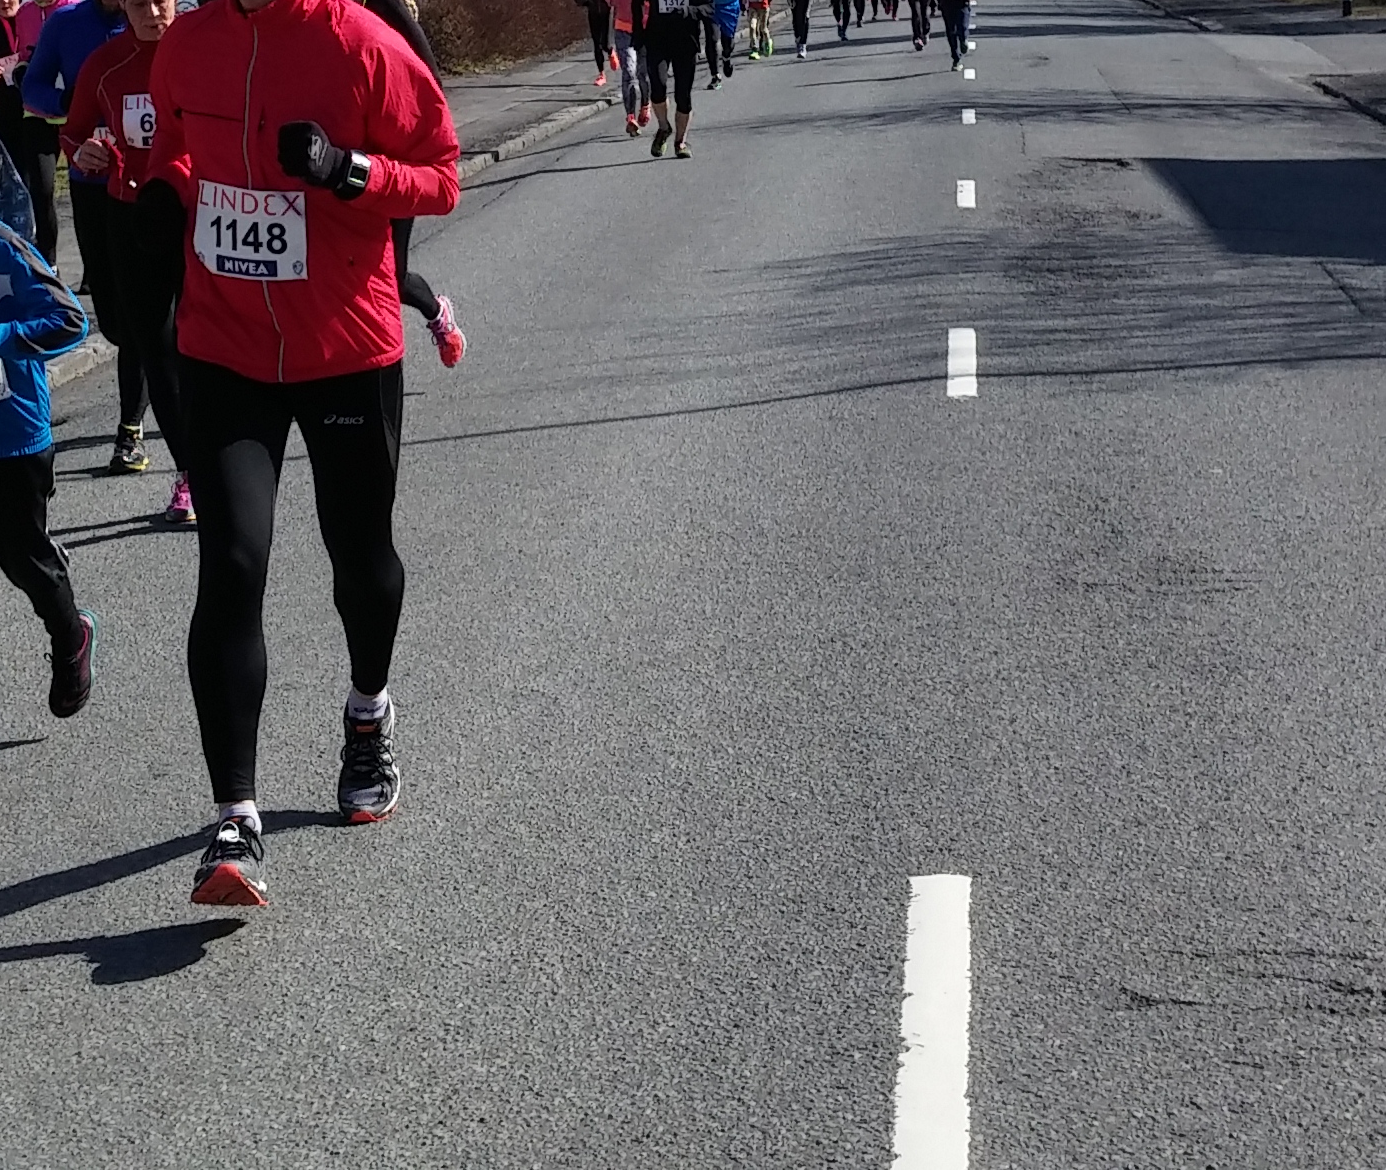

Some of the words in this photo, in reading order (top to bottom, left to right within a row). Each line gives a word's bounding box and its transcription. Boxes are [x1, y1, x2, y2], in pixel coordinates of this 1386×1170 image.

[140, 113, 153, 133] 6
[199, 183, 302, 217] LINDEX
[210, 215, 288, 254] 1148
[224, 258, 269, 274] NIVEA
[337, 416, 364, 424] asics
